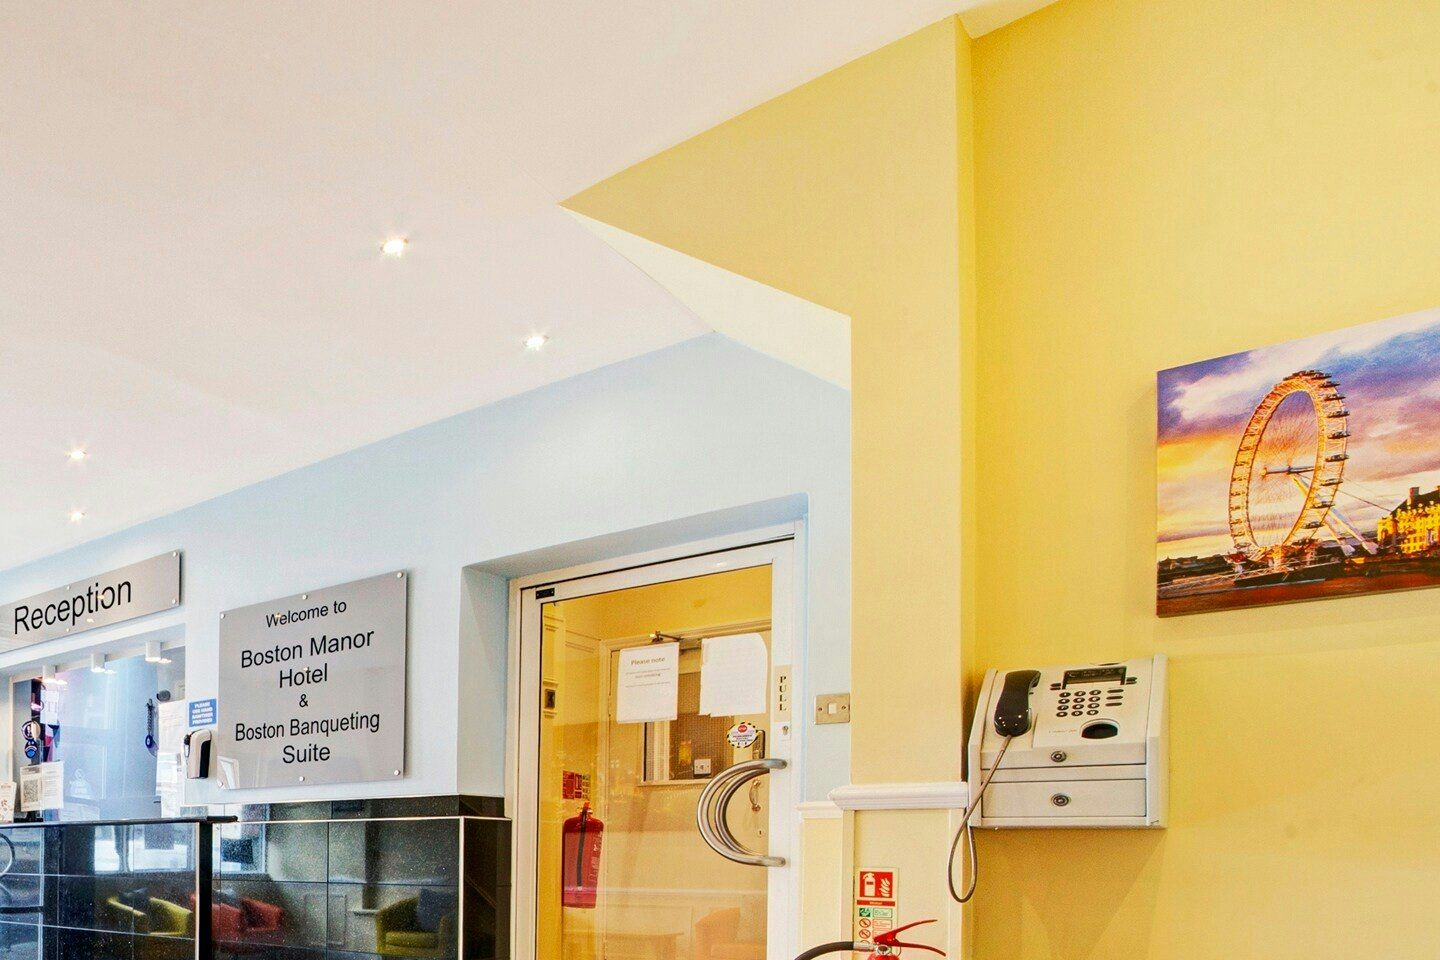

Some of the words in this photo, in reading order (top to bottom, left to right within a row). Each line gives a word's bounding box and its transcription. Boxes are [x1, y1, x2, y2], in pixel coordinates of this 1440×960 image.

[14, 581, 131, 634] Reception
[266, 605, 329, 628] Welcome
[333, 600, 347, 614] to
[241, 644, 302, 668] Boston
[310, 630, 375, 656] Manor
[279, 663, 328, 688] Hotel
[298, 693, 309, 708] &
[779, 676, 787, 711] PULL
[235, 722, 285, 741] Boston
[290, 711, 380, 737] Banqueting
[282, 743, 331, 764] Suite
